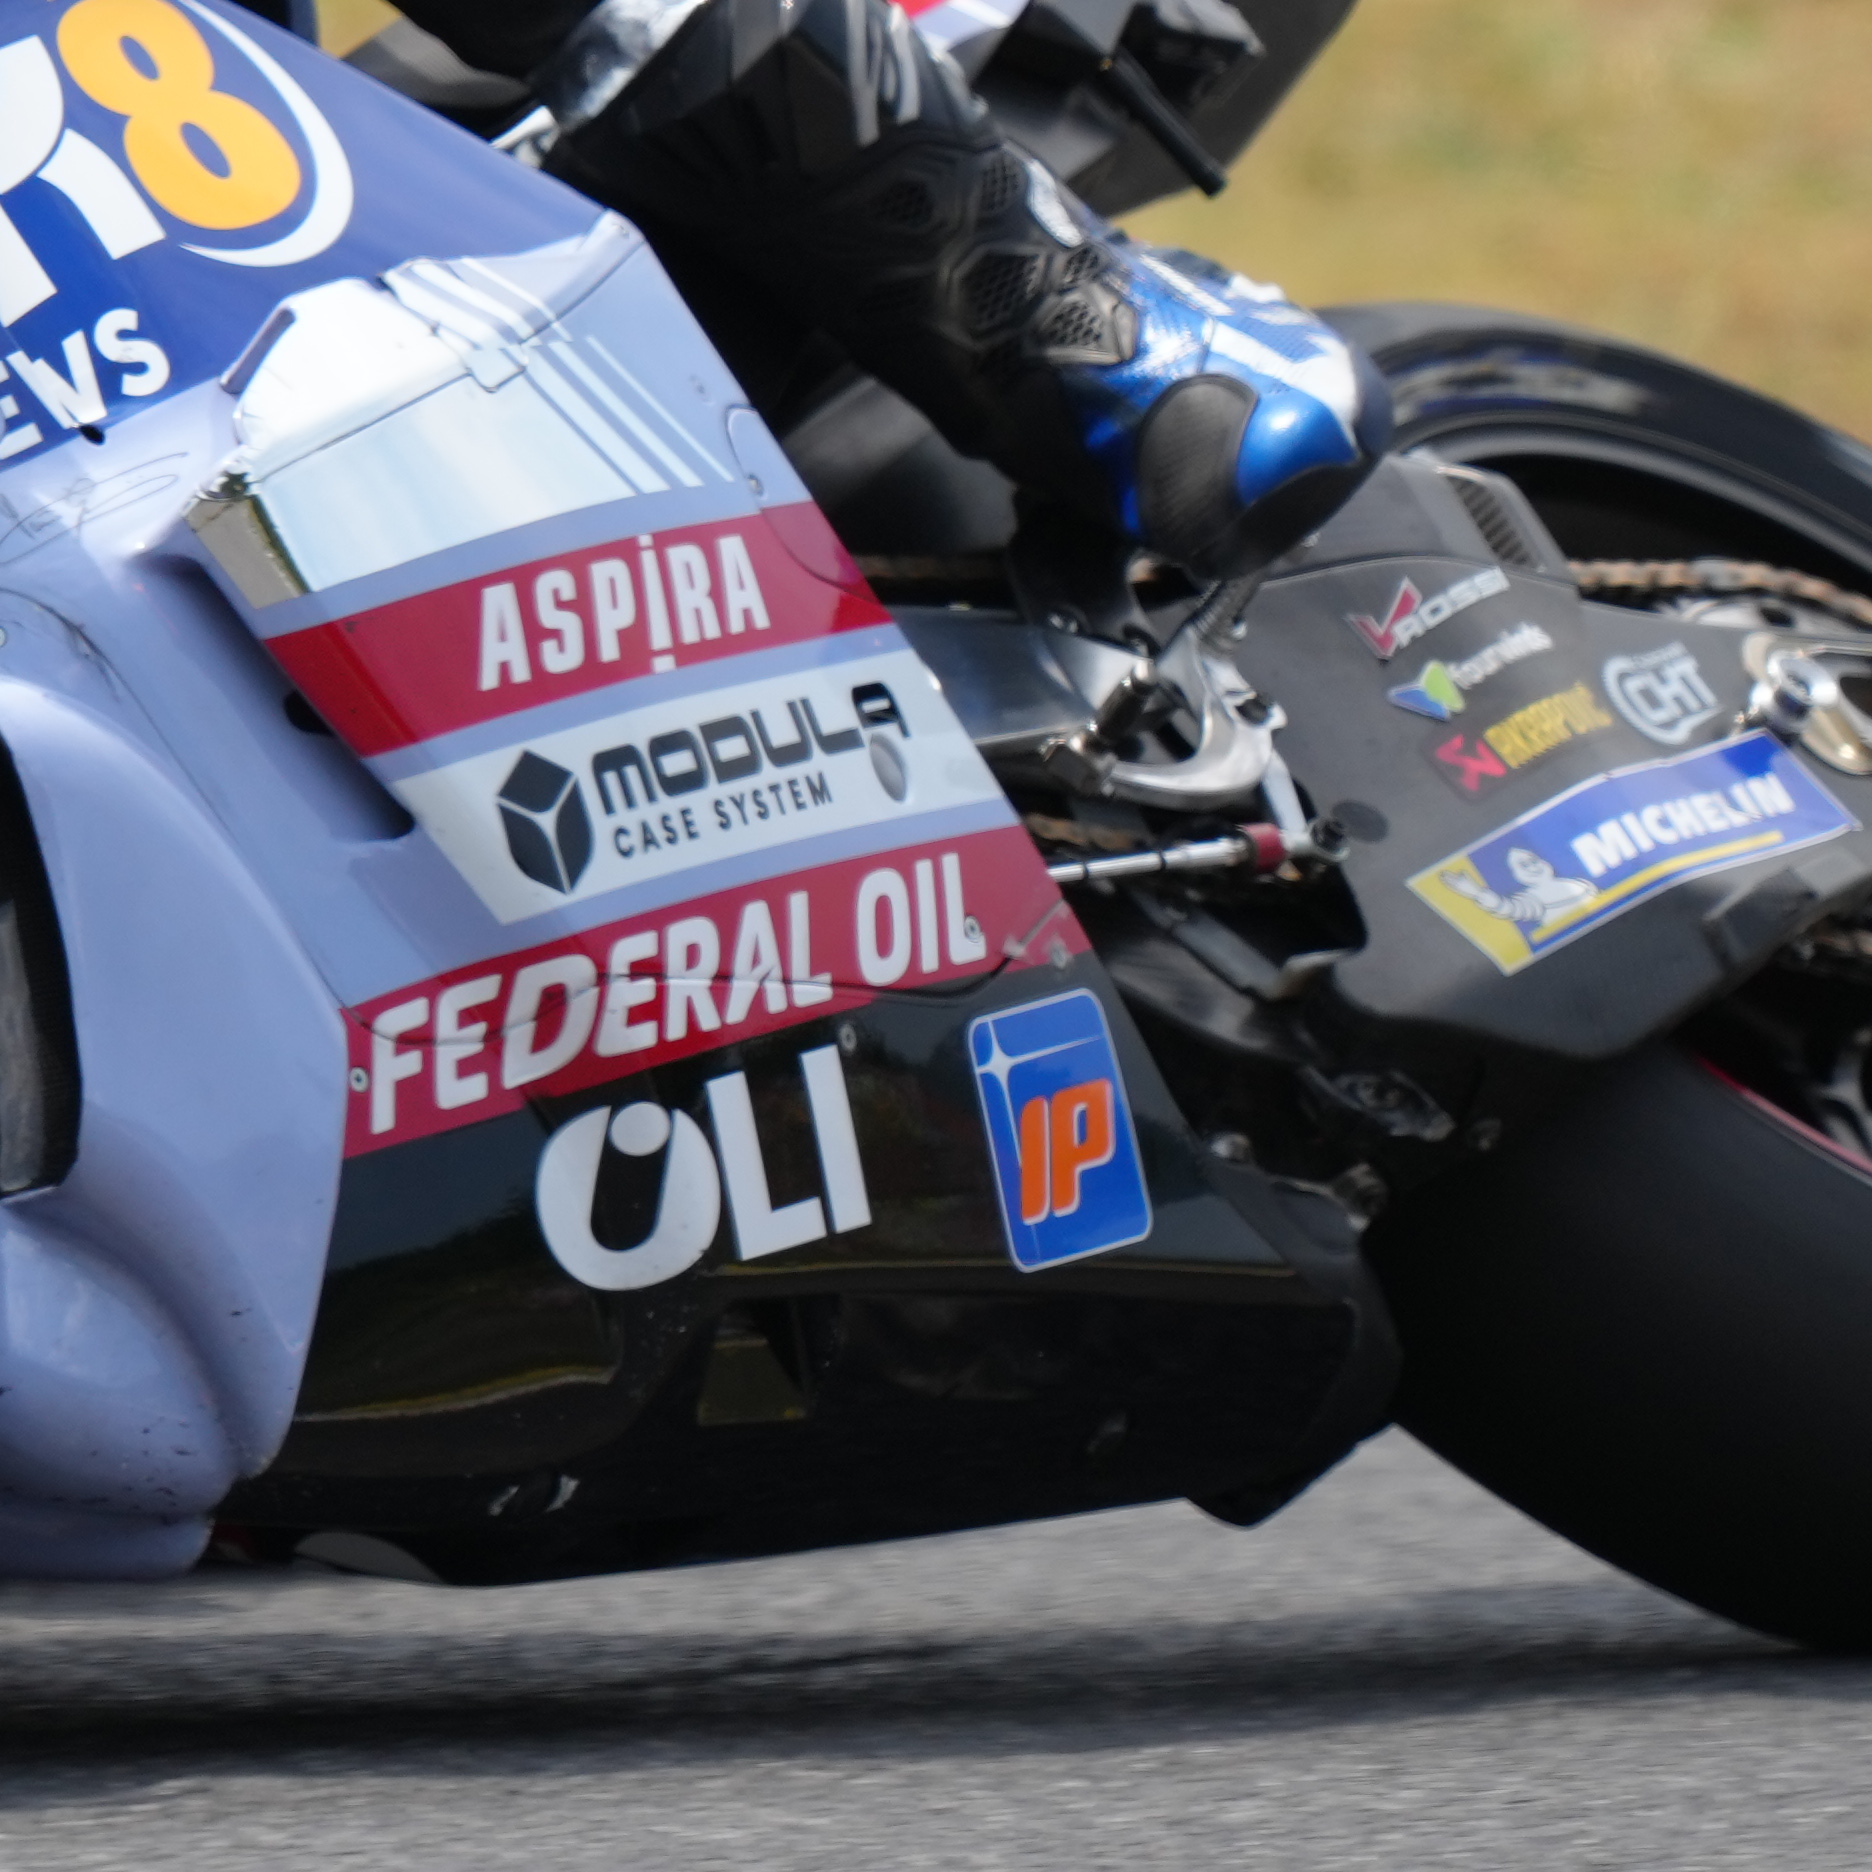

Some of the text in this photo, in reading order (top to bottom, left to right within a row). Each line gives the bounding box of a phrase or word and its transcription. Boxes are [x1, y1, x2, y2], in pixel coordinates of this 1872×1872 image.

[591, 682, 913, 818] MODULA
[612, 770, 833, 860] CASE SYSTEM
[1569, 771, 1797, 878] MICHELIN
[370, 852, 987, 1134] FEDERAL OIL
